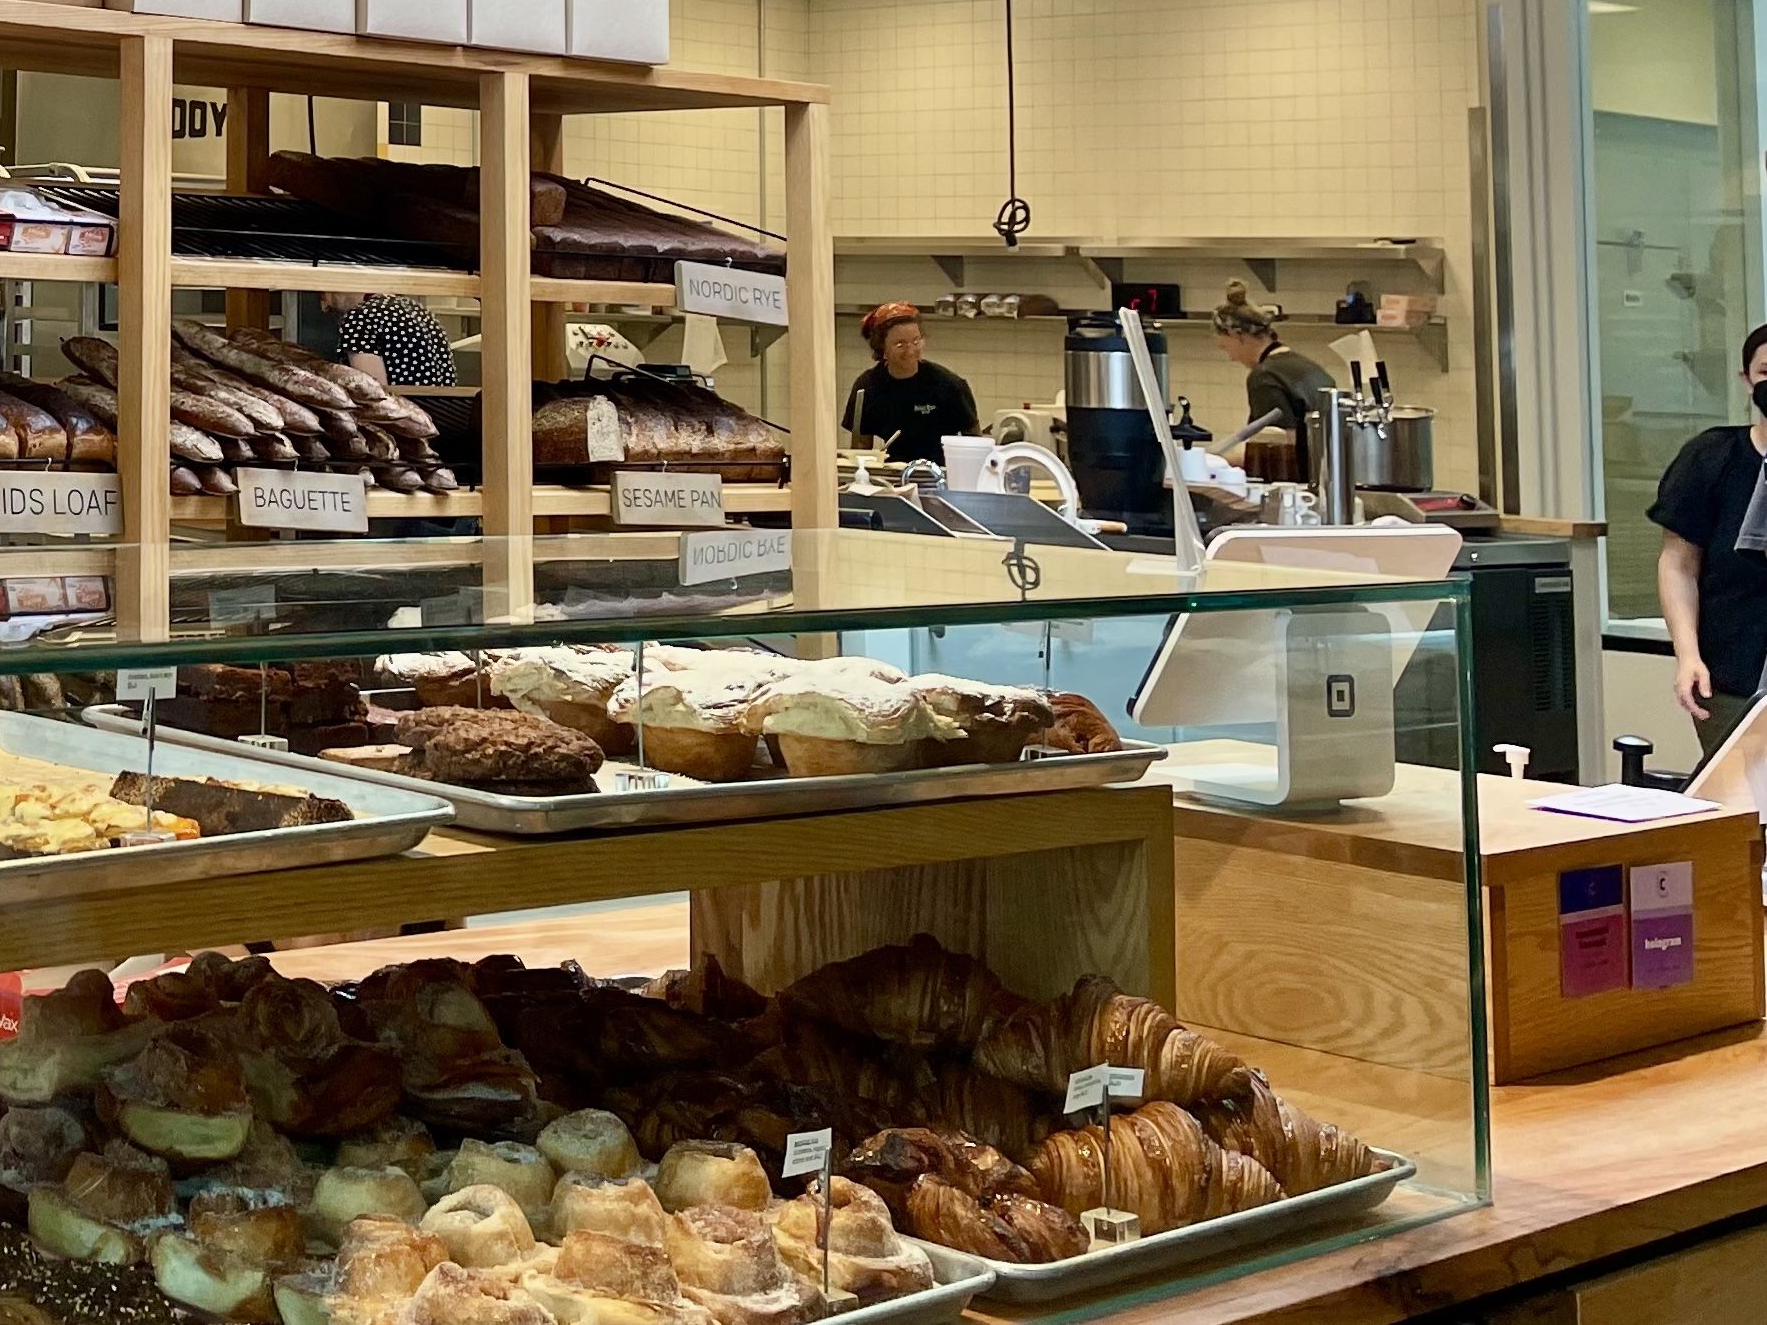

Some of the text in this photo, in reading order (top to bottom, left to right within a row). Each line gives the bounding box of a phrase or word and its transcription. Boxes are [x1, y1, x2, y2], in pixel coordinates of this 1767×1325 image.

[689, 278, 781, 310] NORDIC RYE
[52, 488, 117, 516] LOAF
[253, 486, 352, 513] BAGUETTE
[621, 487, 722, 509] SESAME PAN
